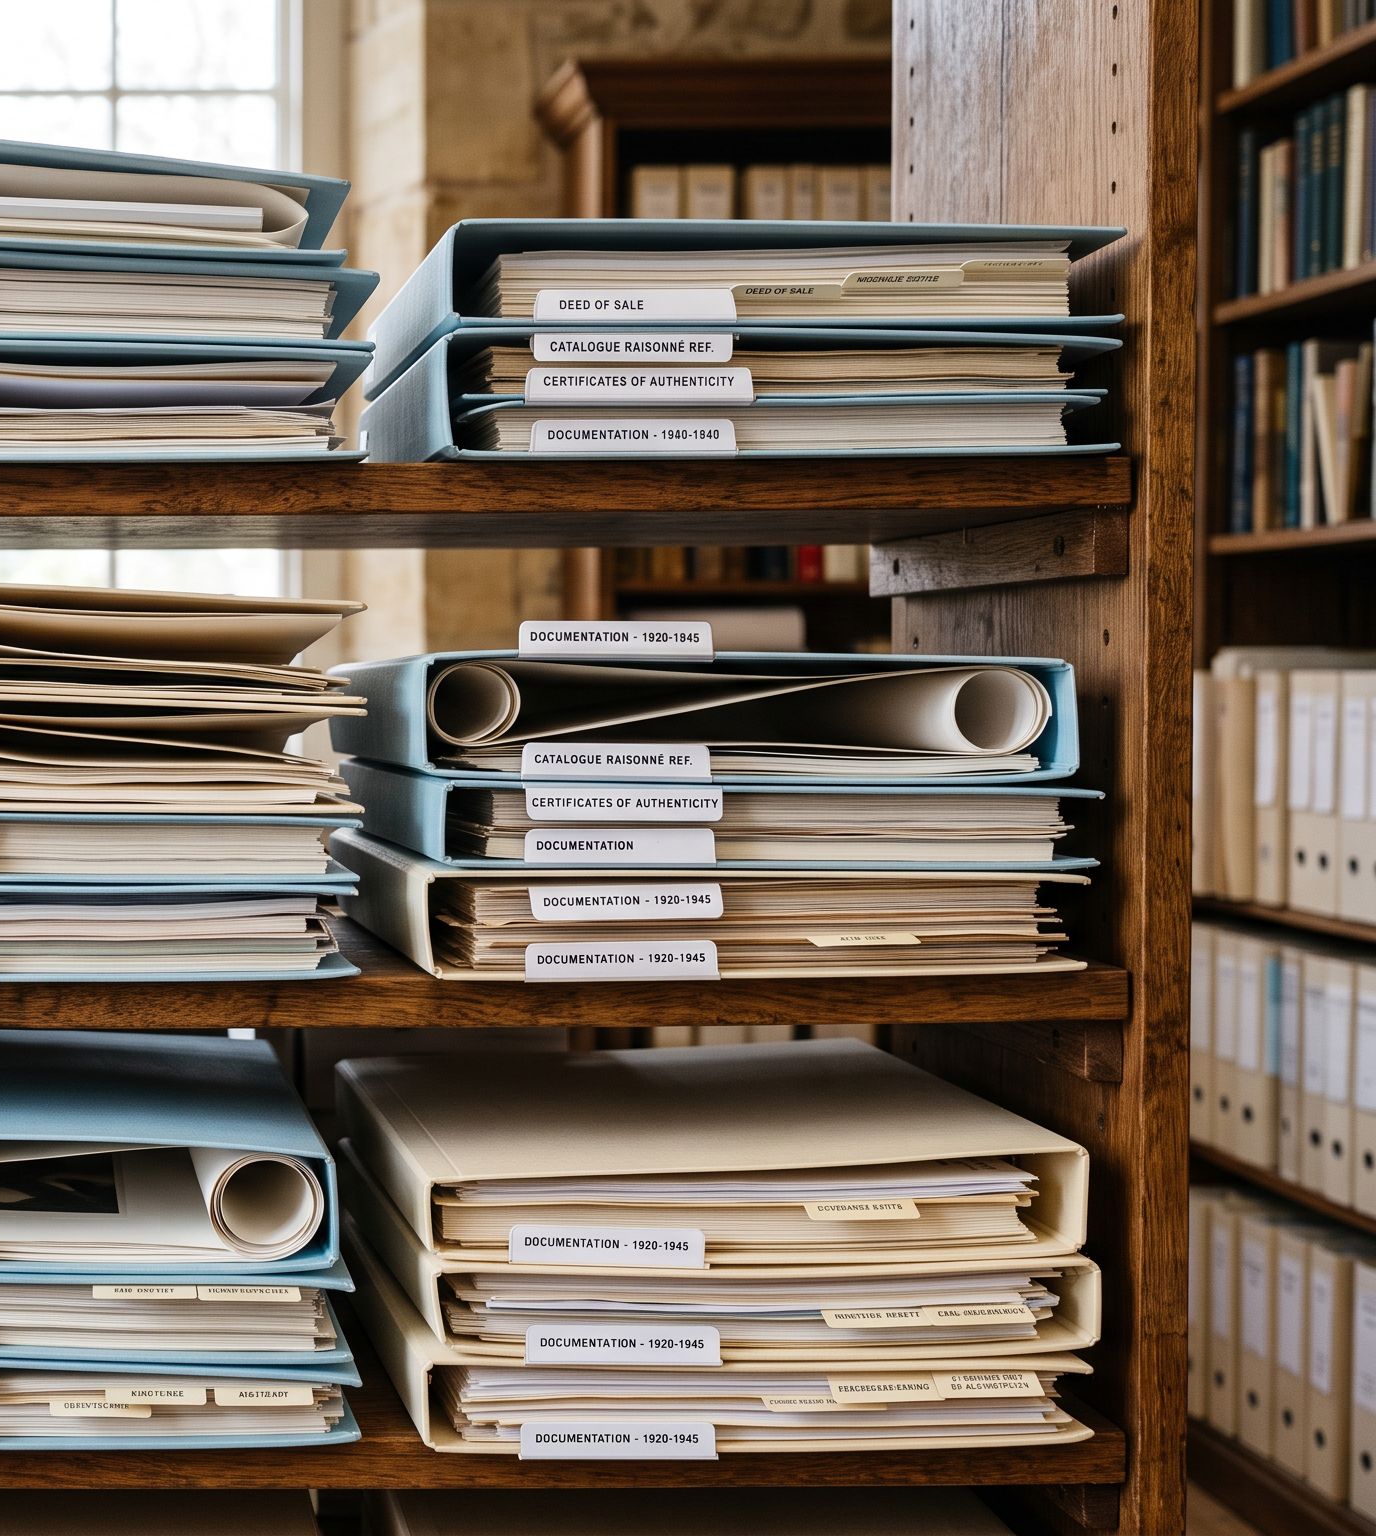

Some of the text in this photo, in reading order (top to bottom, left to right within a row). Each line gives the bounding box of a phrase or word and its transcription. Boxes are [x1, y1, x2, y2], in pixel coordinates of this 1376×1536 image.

[745, 287, 815, 295] DEED OF SALE
[559, 299, 644, 310] DEED OF SALE
[550, 339, 714, 353] CATALOGUE RAISONNÉ REF.
[543, 375, 735, 387] CERTIFICATES OF AUTHENTICITY
[547, 429, 649, 440] DOCUMENTATION
[530, 631, 629, 642] DOCUMENTATION
[534, 753, 693, 766] CATALOGUE RAISONNÉ REF.
[531, 797, 719, 809] CERTIFICATES OF AUTHENTICITY
[536, 840, 634, 851] DOCUMENTATION
[543, 895, 640, 907] DOCUMENTATION
[654, 894, 711, 905] 1920-1945
[537, 953, 635, 965] DOCUMENTATION
[648, 952, 706, 963] 1920-1945
[524, 1236, 620, 1249] DOCUMENTATION
[632, 1240, 689, 1251] 1920-1945
[540, 1337, 636, 1348] DOCUMENTATION
[648, 1338, 705, 1349] 1920-1945
[535, 1433, 631, 1444] DOCUMENTATION
[643, 1433, 699, 1444] 1920-1945
